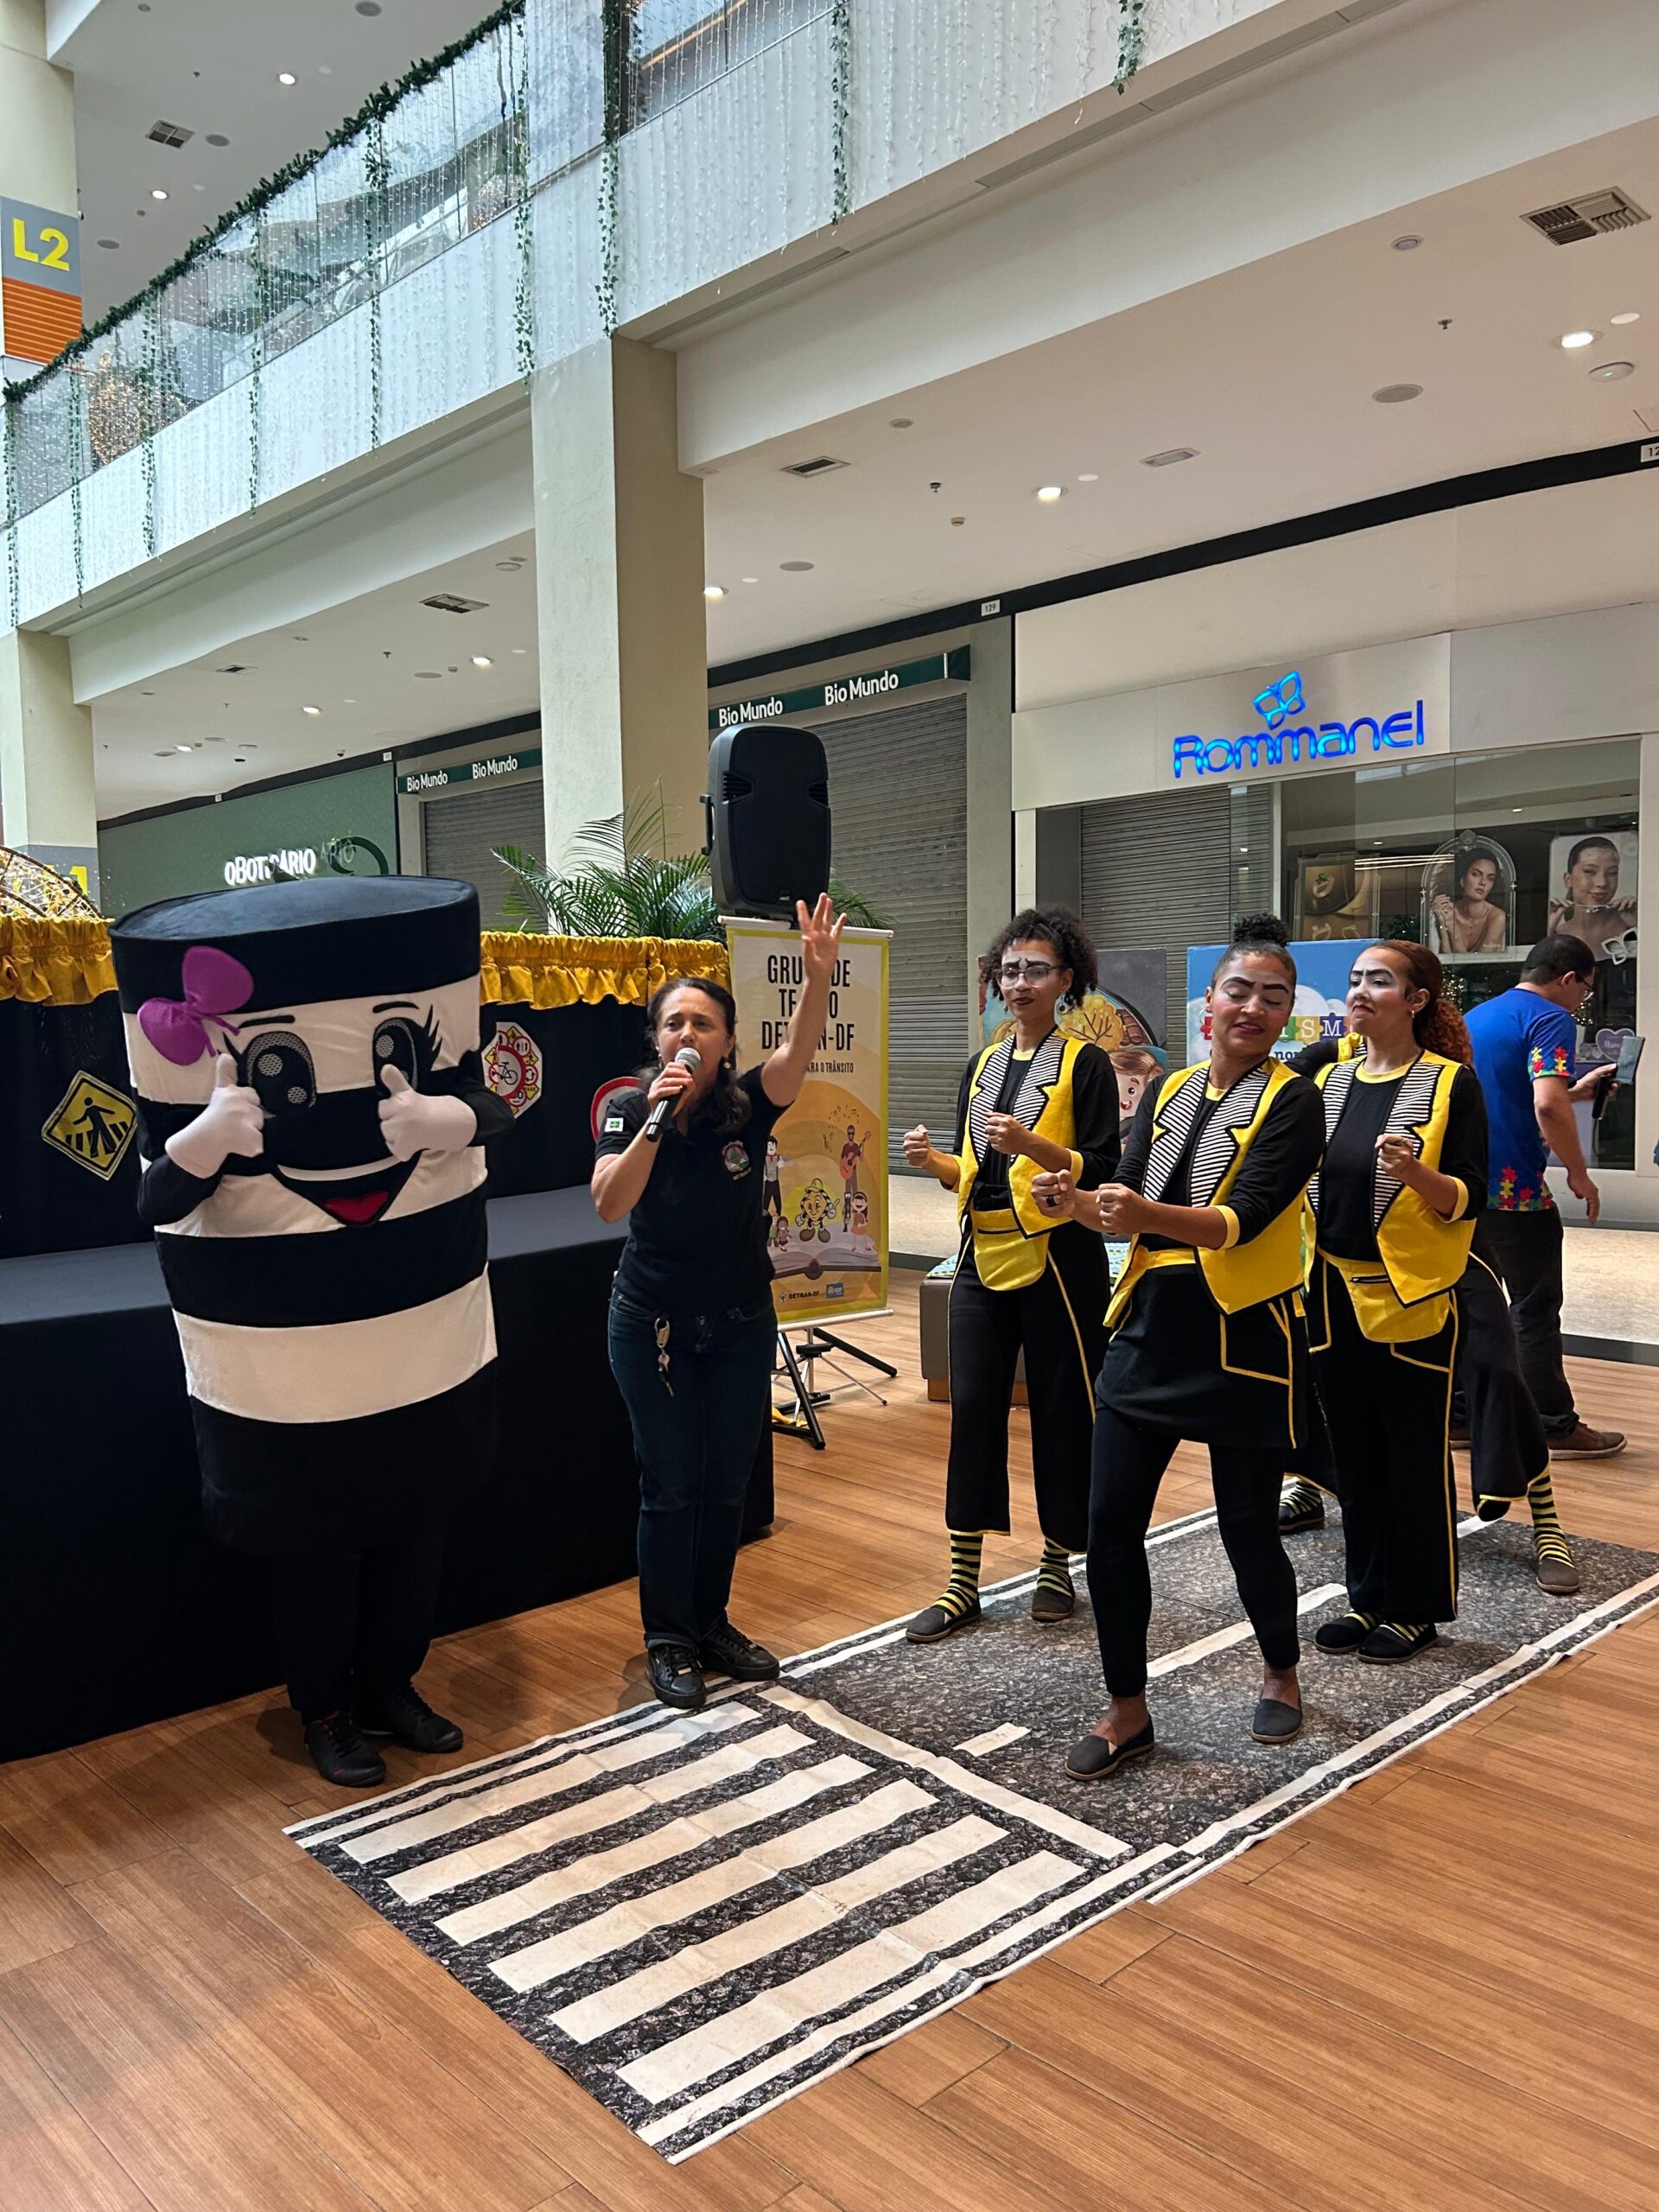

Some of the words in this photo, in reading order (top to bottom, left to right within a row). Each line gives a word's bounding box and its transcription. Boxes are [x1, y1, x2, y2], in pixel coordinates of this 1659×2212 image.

[13, 218, 69, 271] L2
[985, 603, 996, 613] 129
[824, 683, 848, 706] Bio
[849, 671, 899, 701] Mundo
[719, 708, 739, 728] Bio
[740, 696, 784, 723] Mundo
[1173, 700, 1424, 778] Rommanel
[406, 777, 420, 792] Bio
[420, 770, 448, 790] Mundo
[472, 761, 486, 779] Bio
[486, 755, 518, 776] Mundo
[767, 955, 804, 984] GRU
[825, 1060, 854, 1073] TRÂNSITO
